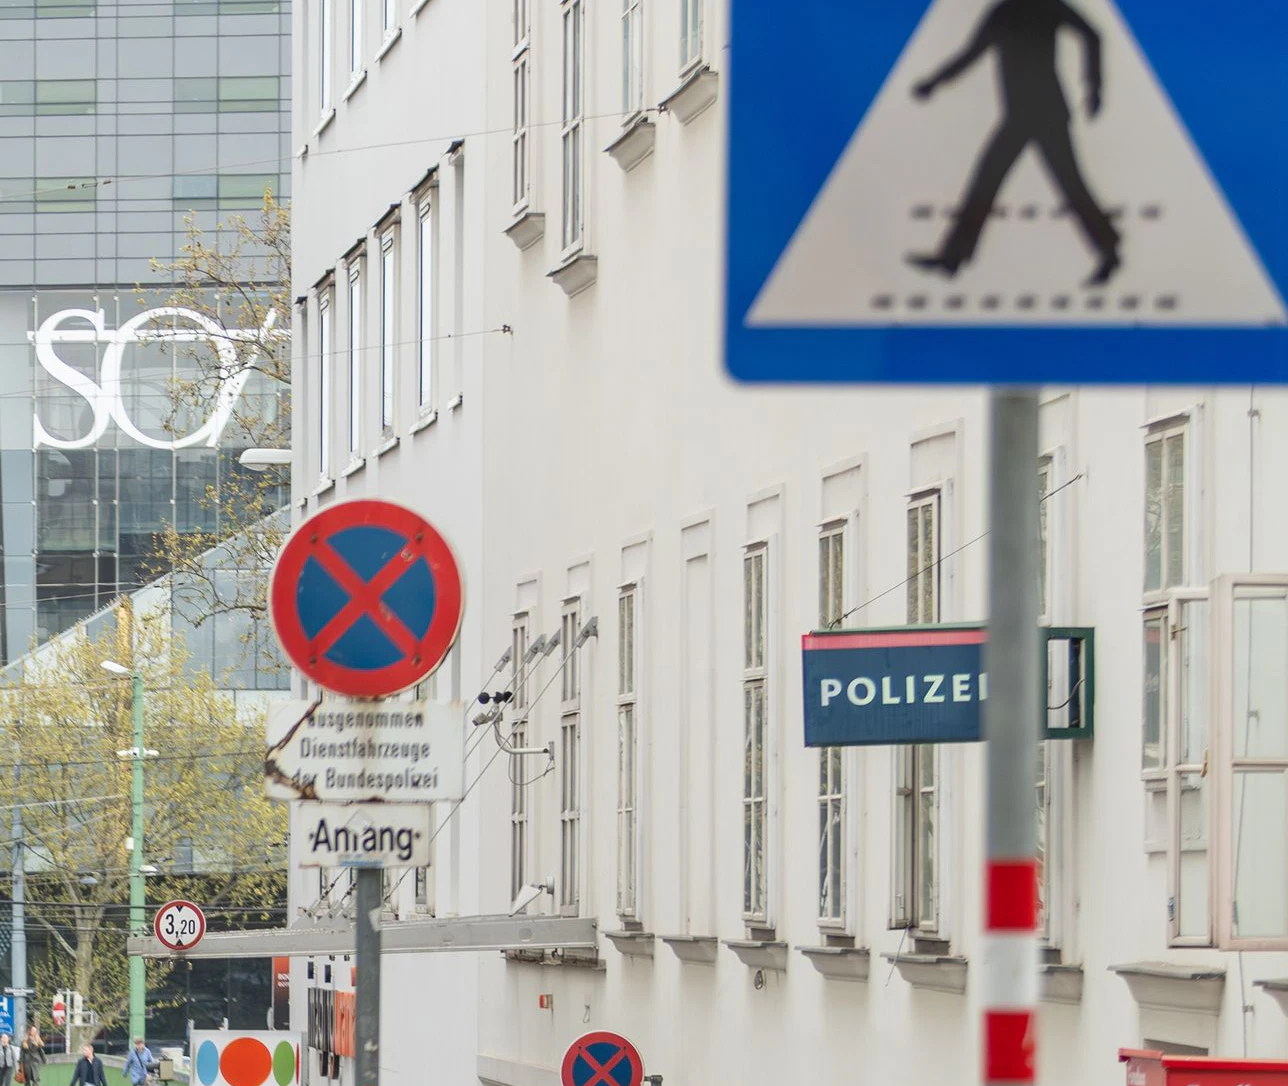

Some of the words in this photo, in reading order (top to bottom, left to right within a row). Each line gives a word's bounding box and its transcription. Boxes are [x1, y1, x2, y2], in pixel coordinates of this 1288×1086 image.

[820, 673, 989, 707] POLIZEI
[307, 711, 424, 733] ausgenommen
[300, 738, 431, 763] Dienstfahrzeuge
[292, 768, 317, 790] der
[325, 767, 439, 793] Bundespolizei
[165, 914, 196, 938] 3,20
